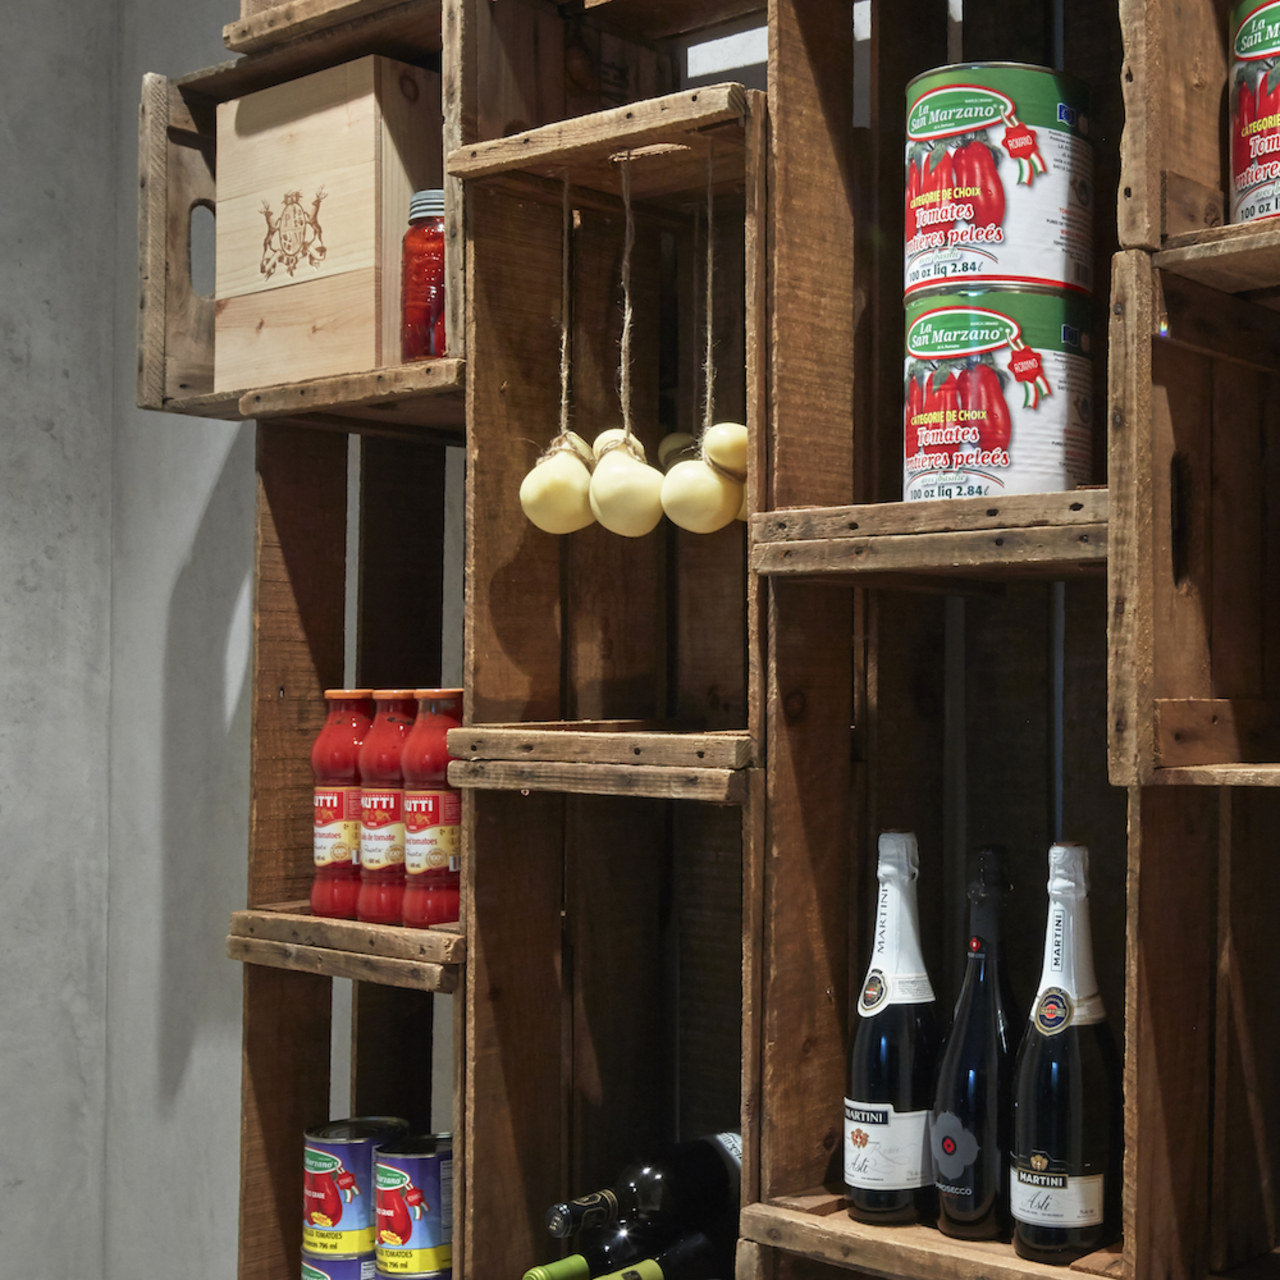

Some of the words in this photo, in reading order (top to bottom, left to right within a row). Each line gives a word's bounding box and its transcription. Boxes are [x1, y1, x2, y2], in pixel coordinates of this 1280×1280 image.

[1251, 19, 1265, 33] La
[1240, 32, 1262, 51] San
[919, 105, 929, 116] La
[911, 116, 926, 132] San
[929, 106, 995, 124] Marzano
[942, 188, 952, 200] DE
[954, 186, 981, 199] CHOIX
[916, 203, 973, 228] Tomates
[1241, 205, 1255, 220] 100
[1258, 200, 1271, 212] oz
[949, 223, 1004, 247] peleés
[921, 268, 932, 278] oz
[934, 263, 947, 277] liq
[920, 323, 932, 335] La
[911, 334, 929, 348] San
[931, 328, 1000, 344] Marzano
[946, 410, 957, 422] DE
[958, 409, 987, 421] CHOIX
[917, 426, 980, 446] Tomates
[953, 448, 1010, 470] peleés
[924, 487, 935, 497] oz
[937, 485, 952, 498] liq
[1053, 914, 1062, 967] MARTINI
[1020, 1171, 1063, 1187] MARTINI
[315, 1230, 343, 1240] TOMATOES
[384, 1249, 413, 1258] TOMATOES
